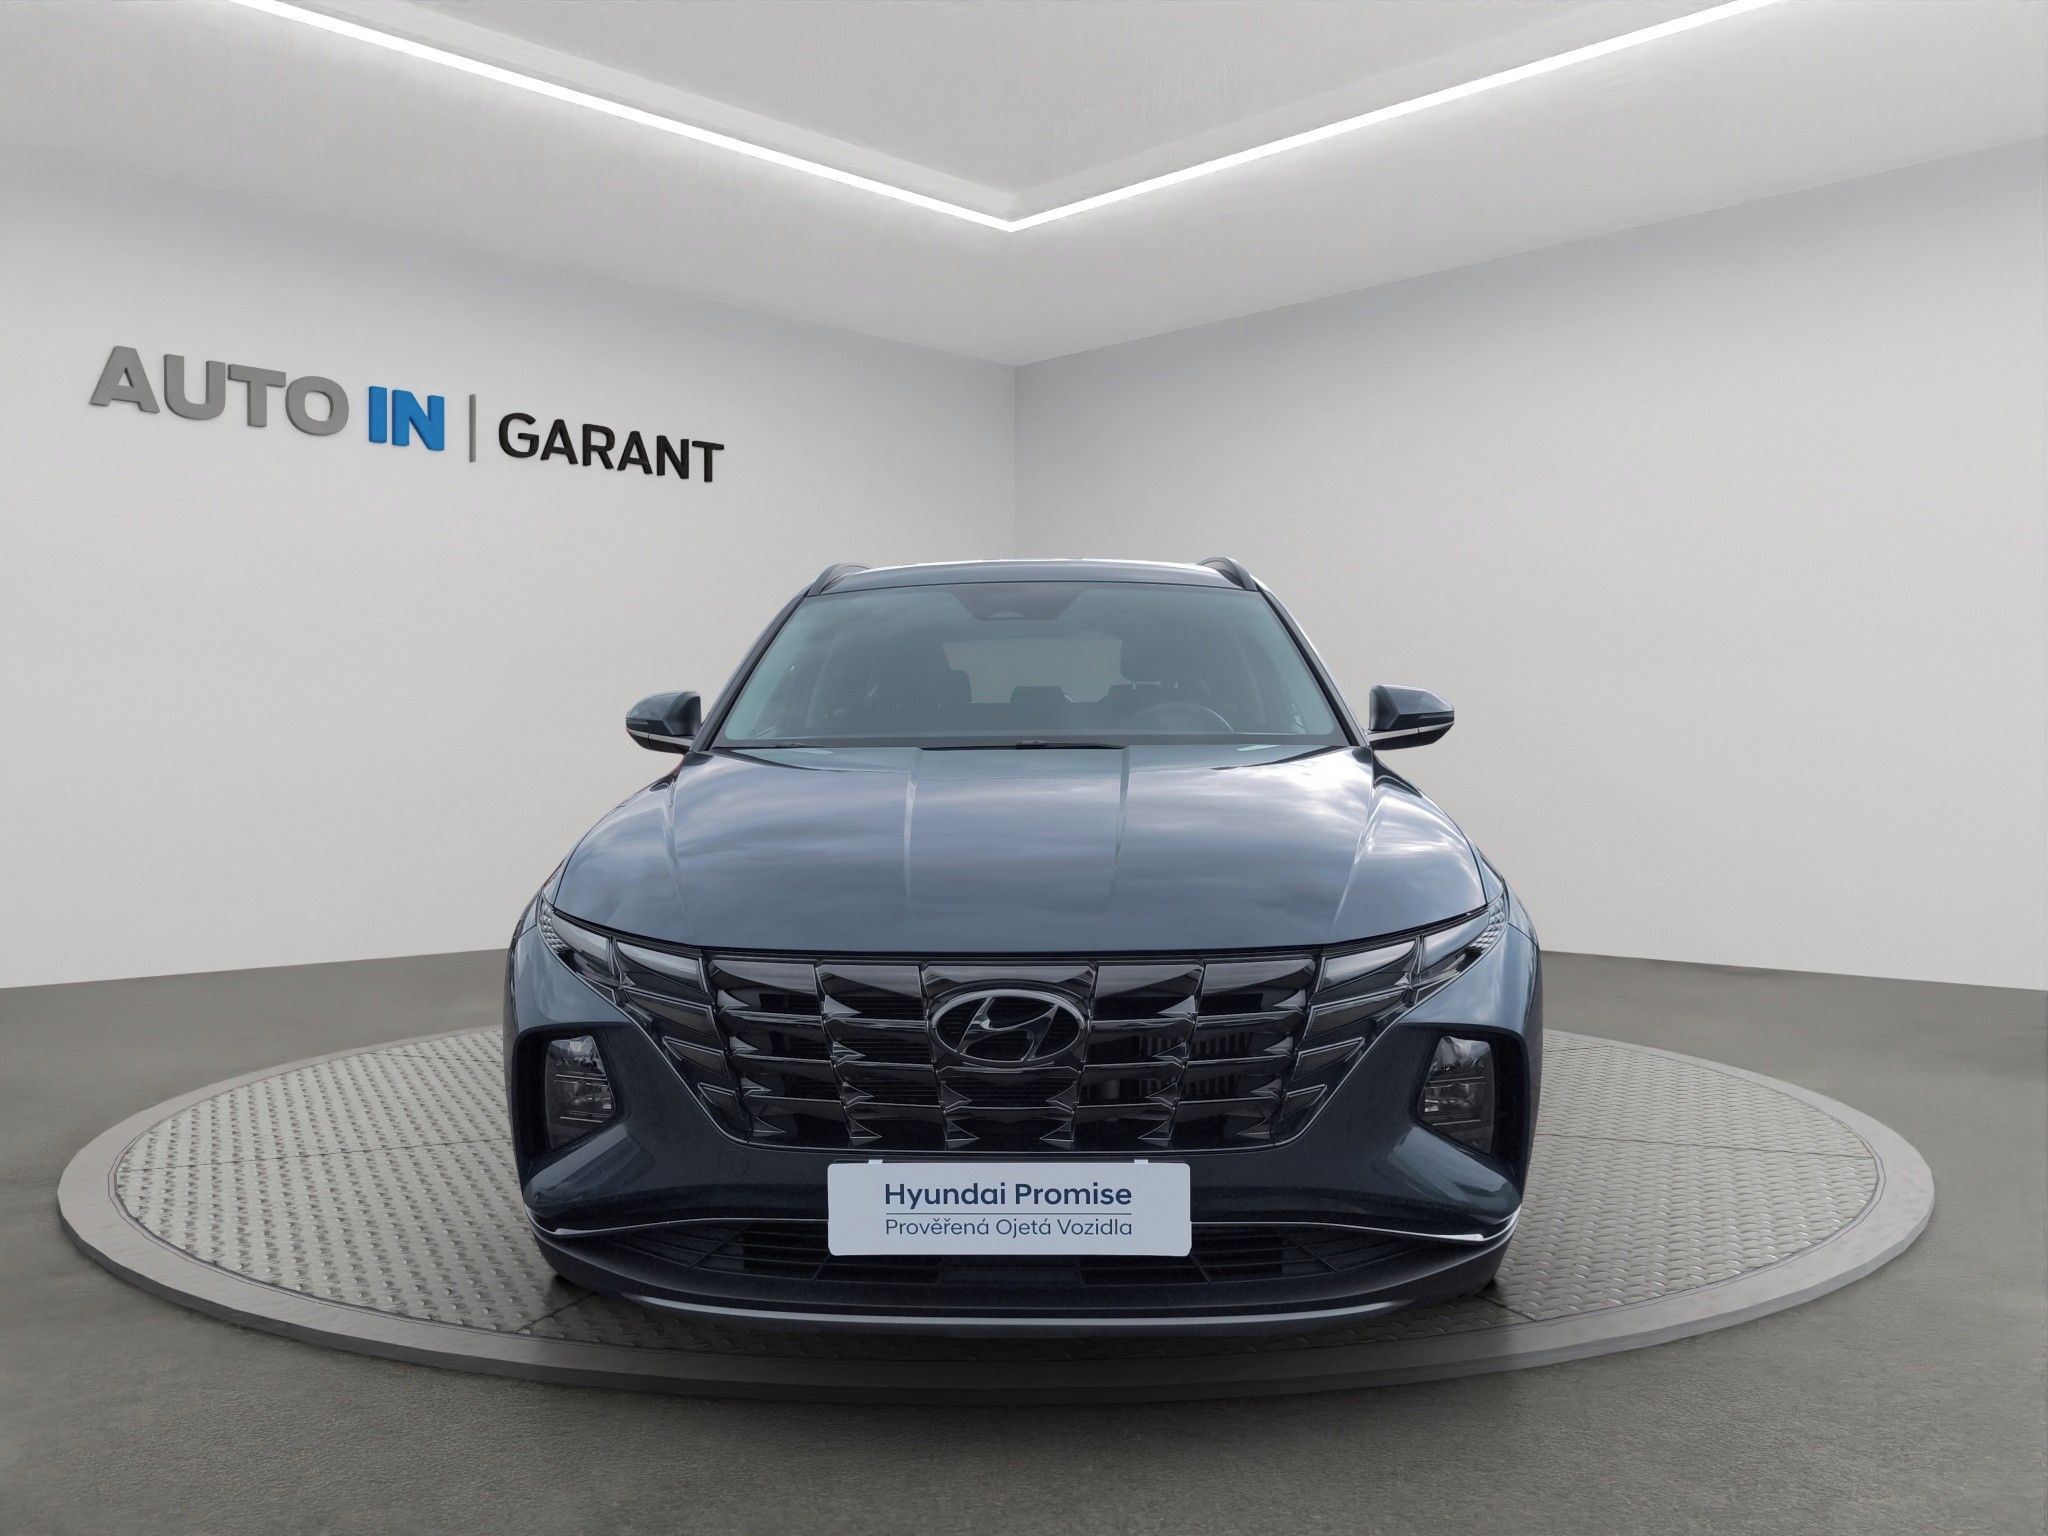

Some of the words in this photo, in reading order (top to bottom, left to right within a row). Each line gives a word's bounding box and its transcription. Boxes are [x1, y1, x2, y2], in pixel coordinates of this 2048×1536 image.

[89, 345, 349, 436] AUTO
[368, 385, 445, 451] IN
[499, 412, 724, 483] GARANT
[885, 1182, 1006, 1210] Hyundai
[1015, 1182, 1132, 1205] Promise
[886, 1217, 989, 1235] Prověřená
[996, 1217, 1051, 1239] Ojetá
[1057, 1218, 1132, 1235] Vozidla
